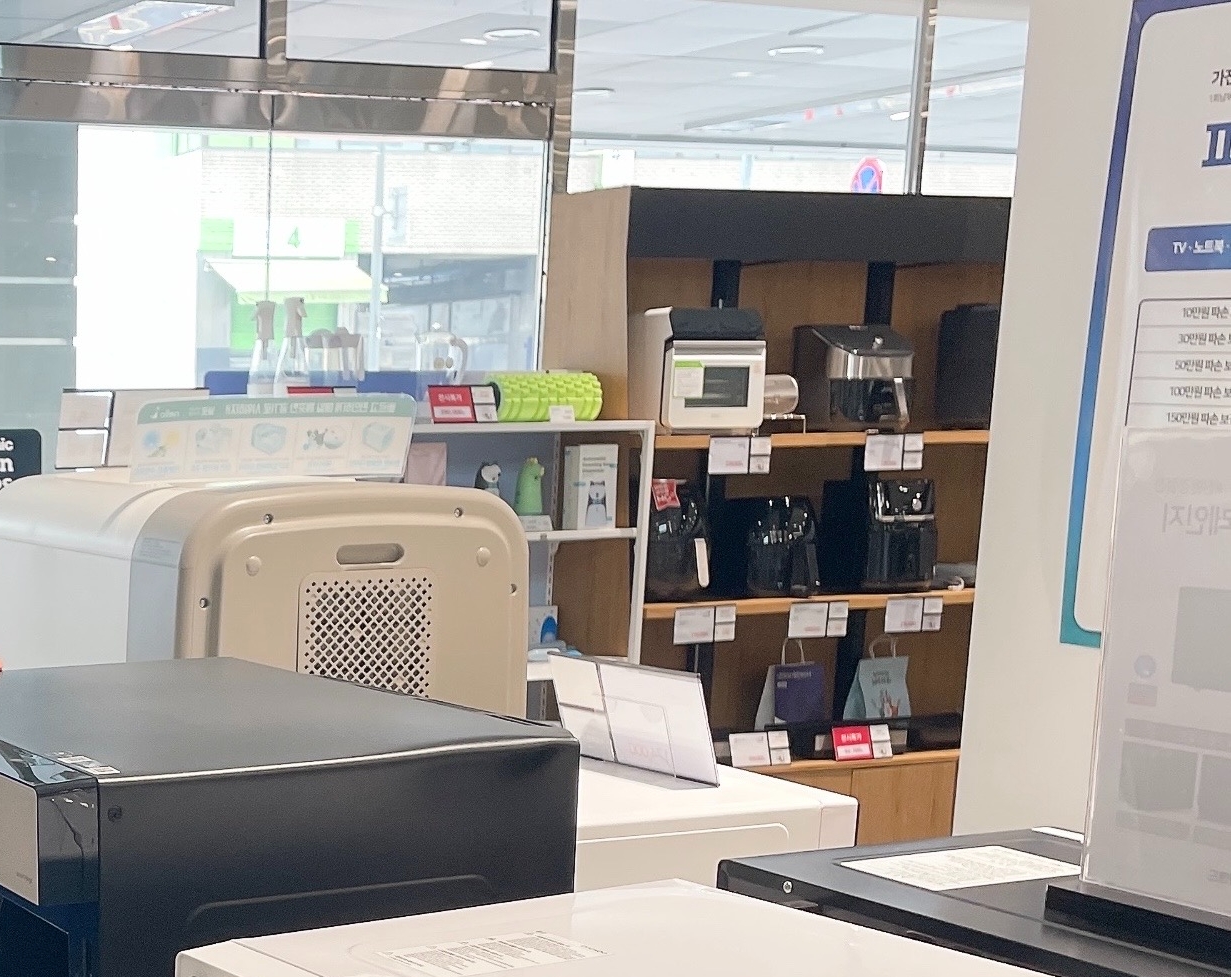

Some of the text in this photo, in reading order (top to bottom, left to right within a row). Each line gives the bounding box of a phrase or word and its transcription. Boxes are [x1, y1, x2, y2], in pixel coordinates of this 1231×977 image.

[1174, 360, 1203, 372] 50만원
[1170, 386, 1202, 399] 100만원
[1167, 412, 1199, 424] 150만원
